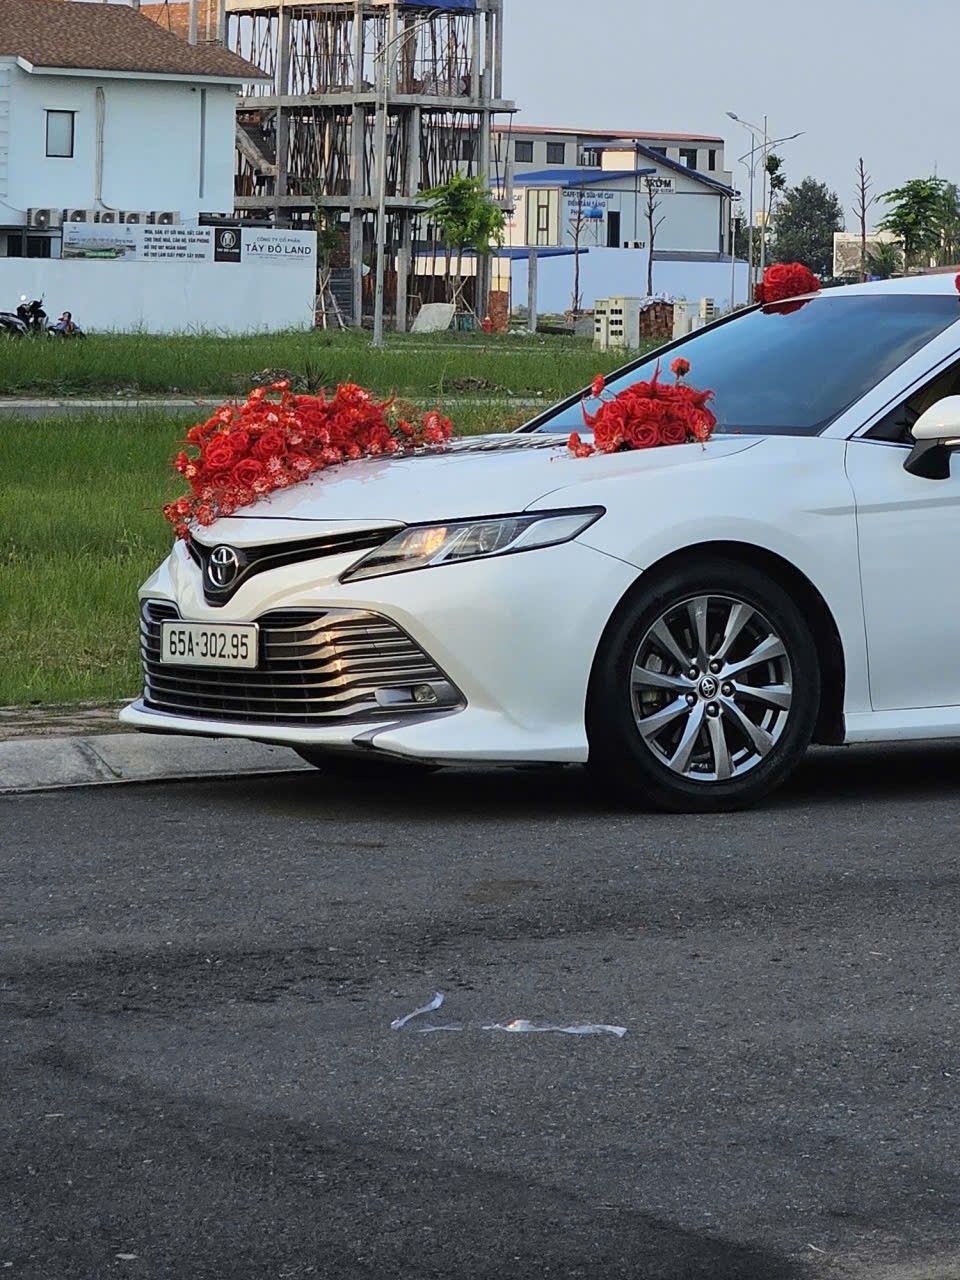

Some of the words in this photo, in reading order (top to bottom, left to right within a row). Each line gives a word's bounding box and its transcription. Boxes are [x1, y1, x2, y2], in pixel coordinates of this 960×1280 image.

[245, 241, 264, 252] TÂY
[268, 243, 282, 254] ĐÔ
[285, 246, 312, 255] LAND
